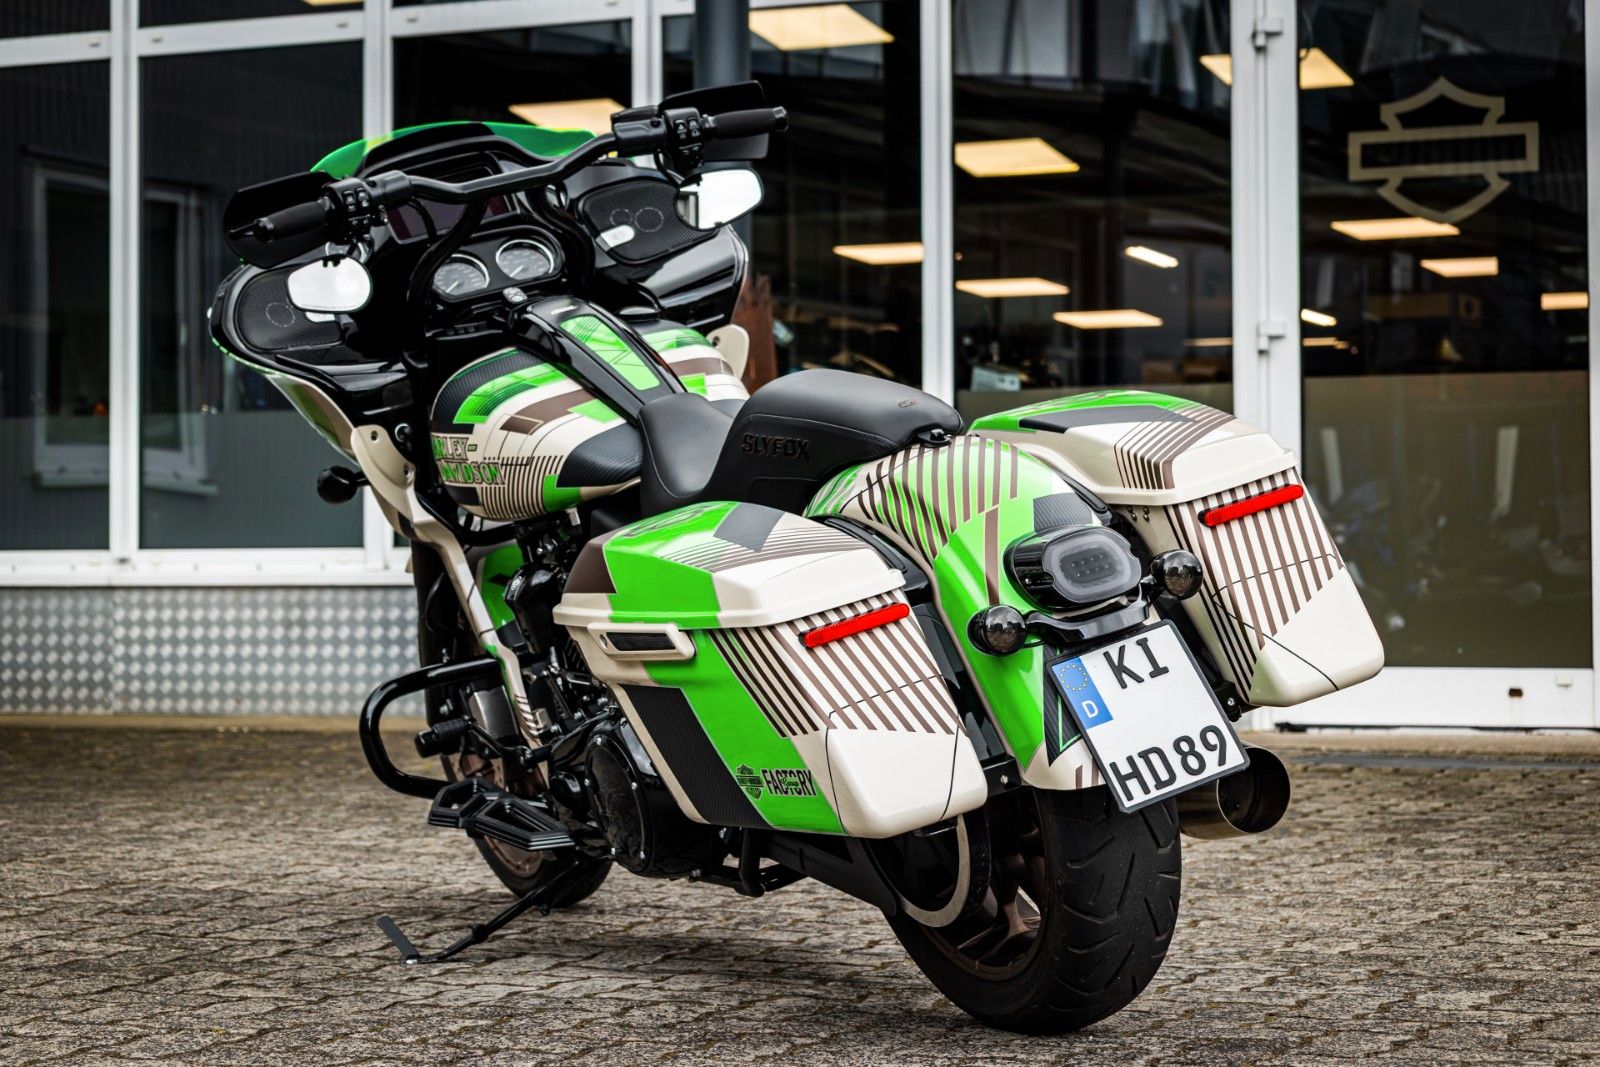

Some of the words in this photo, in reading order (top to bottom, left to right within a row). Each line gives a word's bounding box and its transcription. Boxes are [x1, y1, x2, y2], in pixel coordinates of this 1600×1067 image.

[742, 433, 810, 459] SLYFOX
[1103, 637, 1169, 689] KI
[1081, 700, 1099, 719] D
[761, 769, 817, 796] FACTORY
